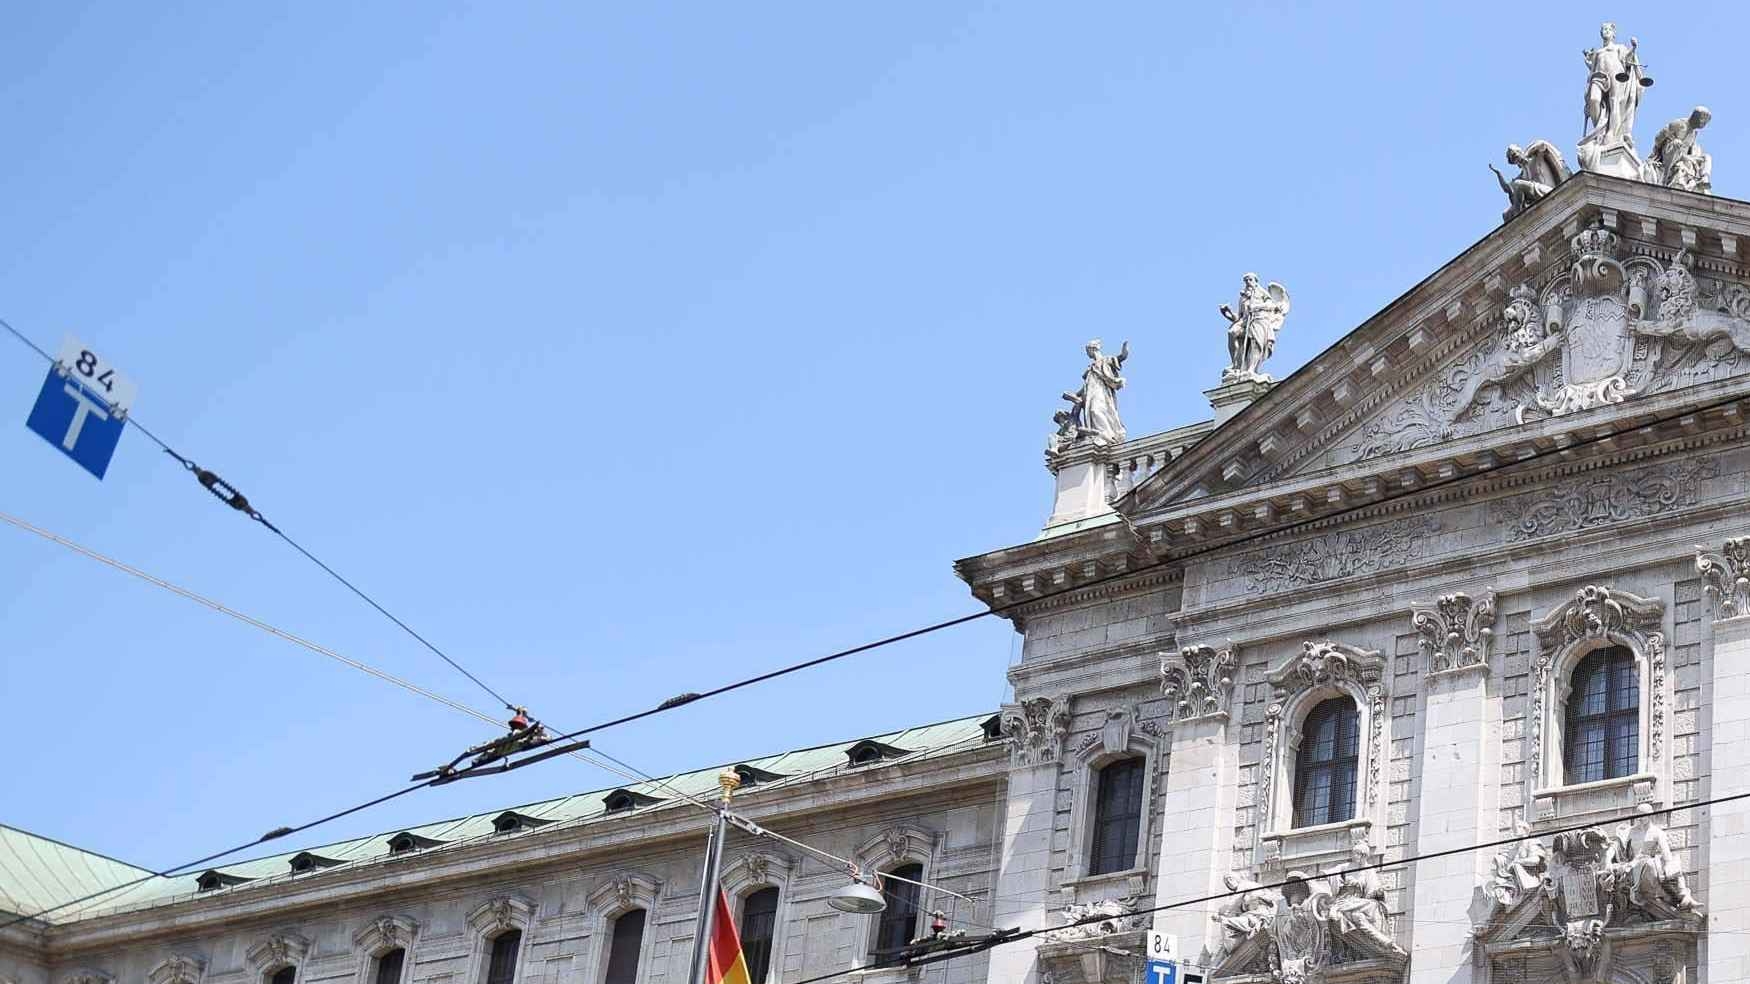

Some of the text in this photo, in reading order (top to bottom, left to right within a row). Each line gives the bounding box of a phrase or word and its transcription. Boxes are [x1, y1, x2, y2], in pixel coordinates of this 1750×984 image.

[75, 349, 116, 392] 84
[62, 382, 109, 452] T
[1153, 934, 1171, 954] 84
